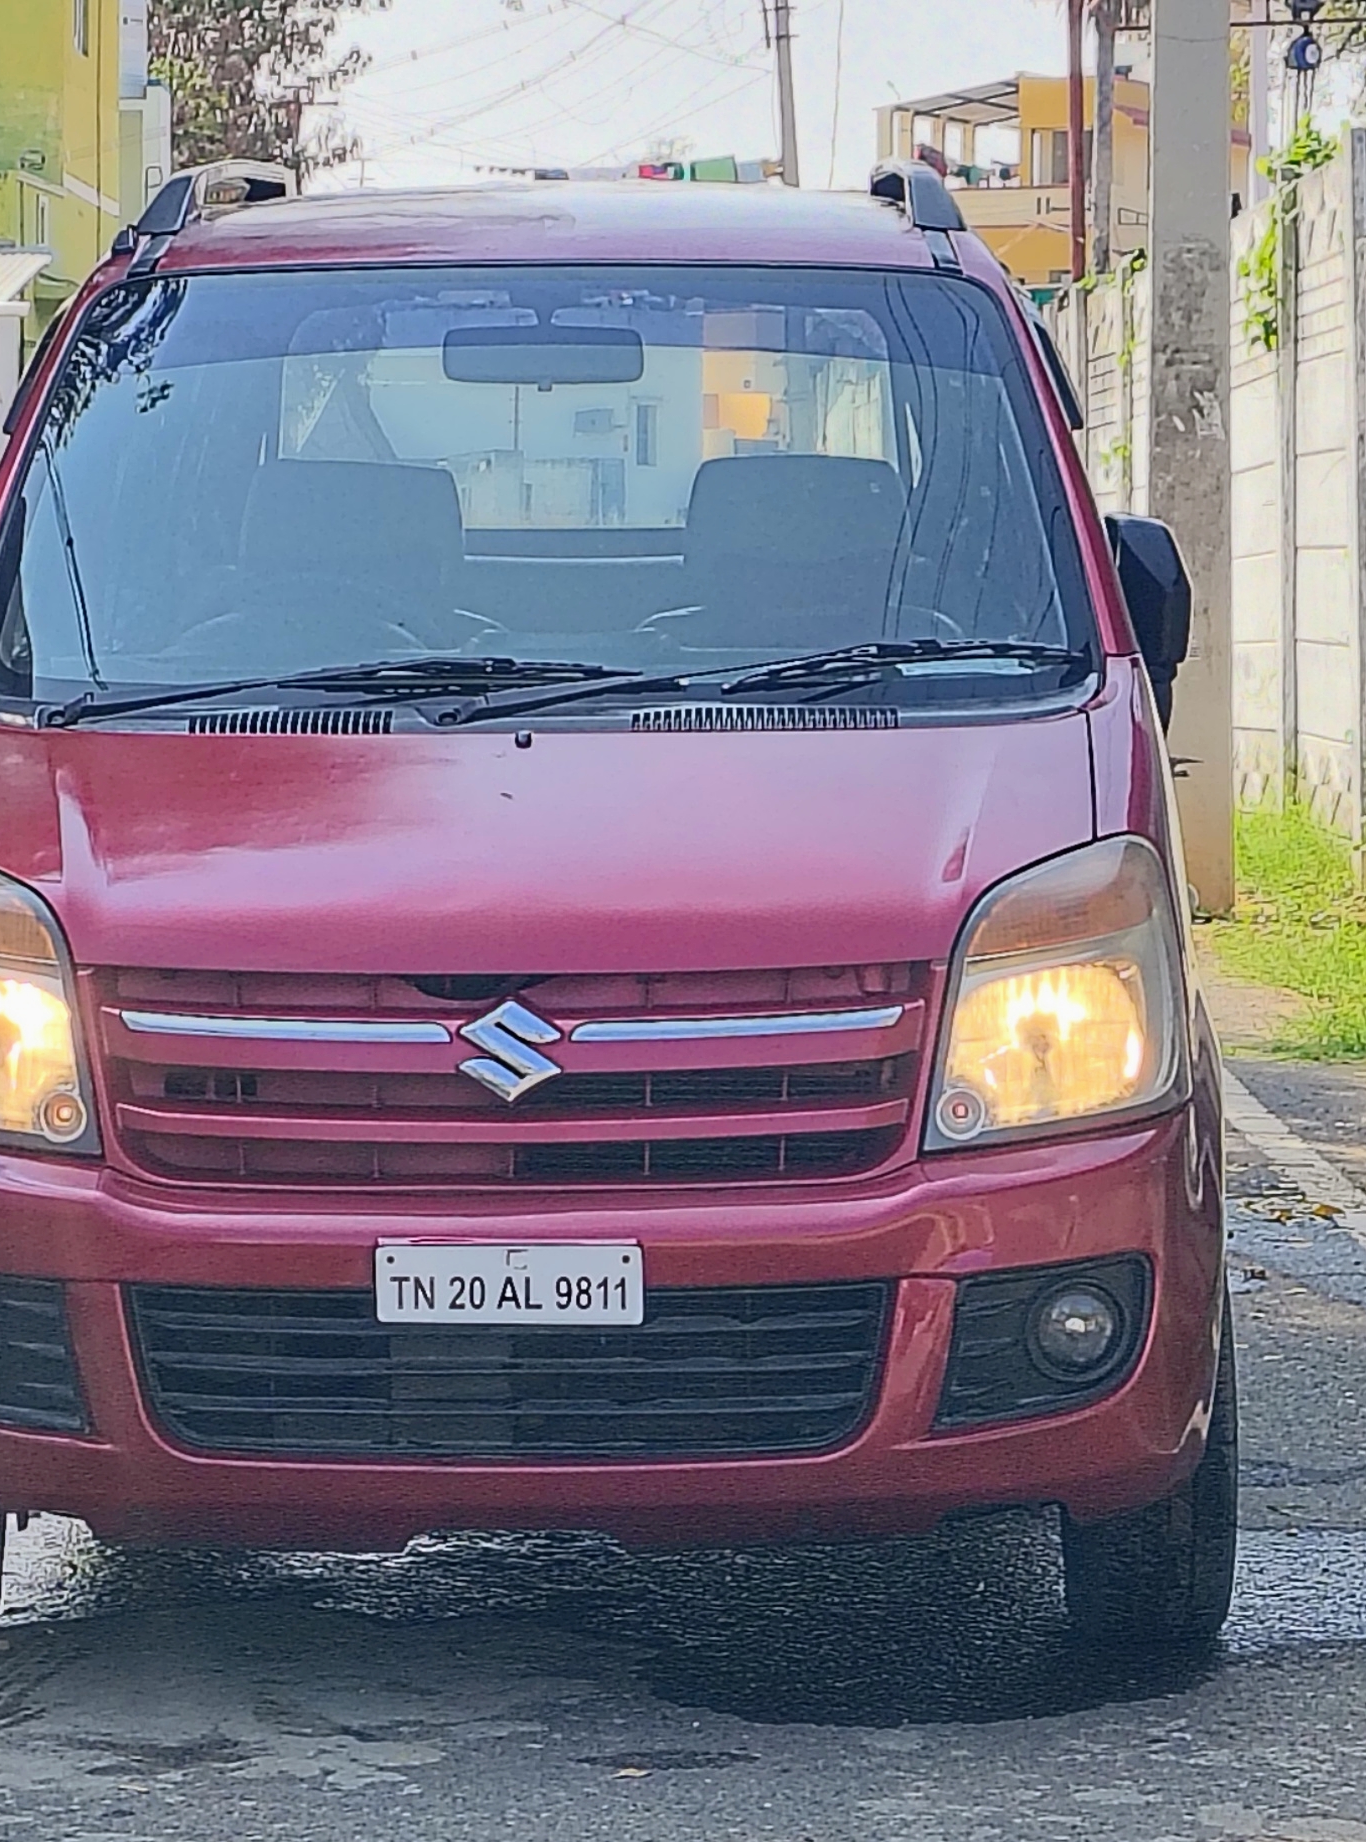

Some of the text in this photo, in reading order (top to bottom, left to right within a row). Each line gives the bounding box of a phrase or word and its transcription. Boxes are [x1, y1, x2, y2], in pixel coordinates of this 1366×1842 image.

[390, 1276, 627, 1310] TN 20 AL 9811
